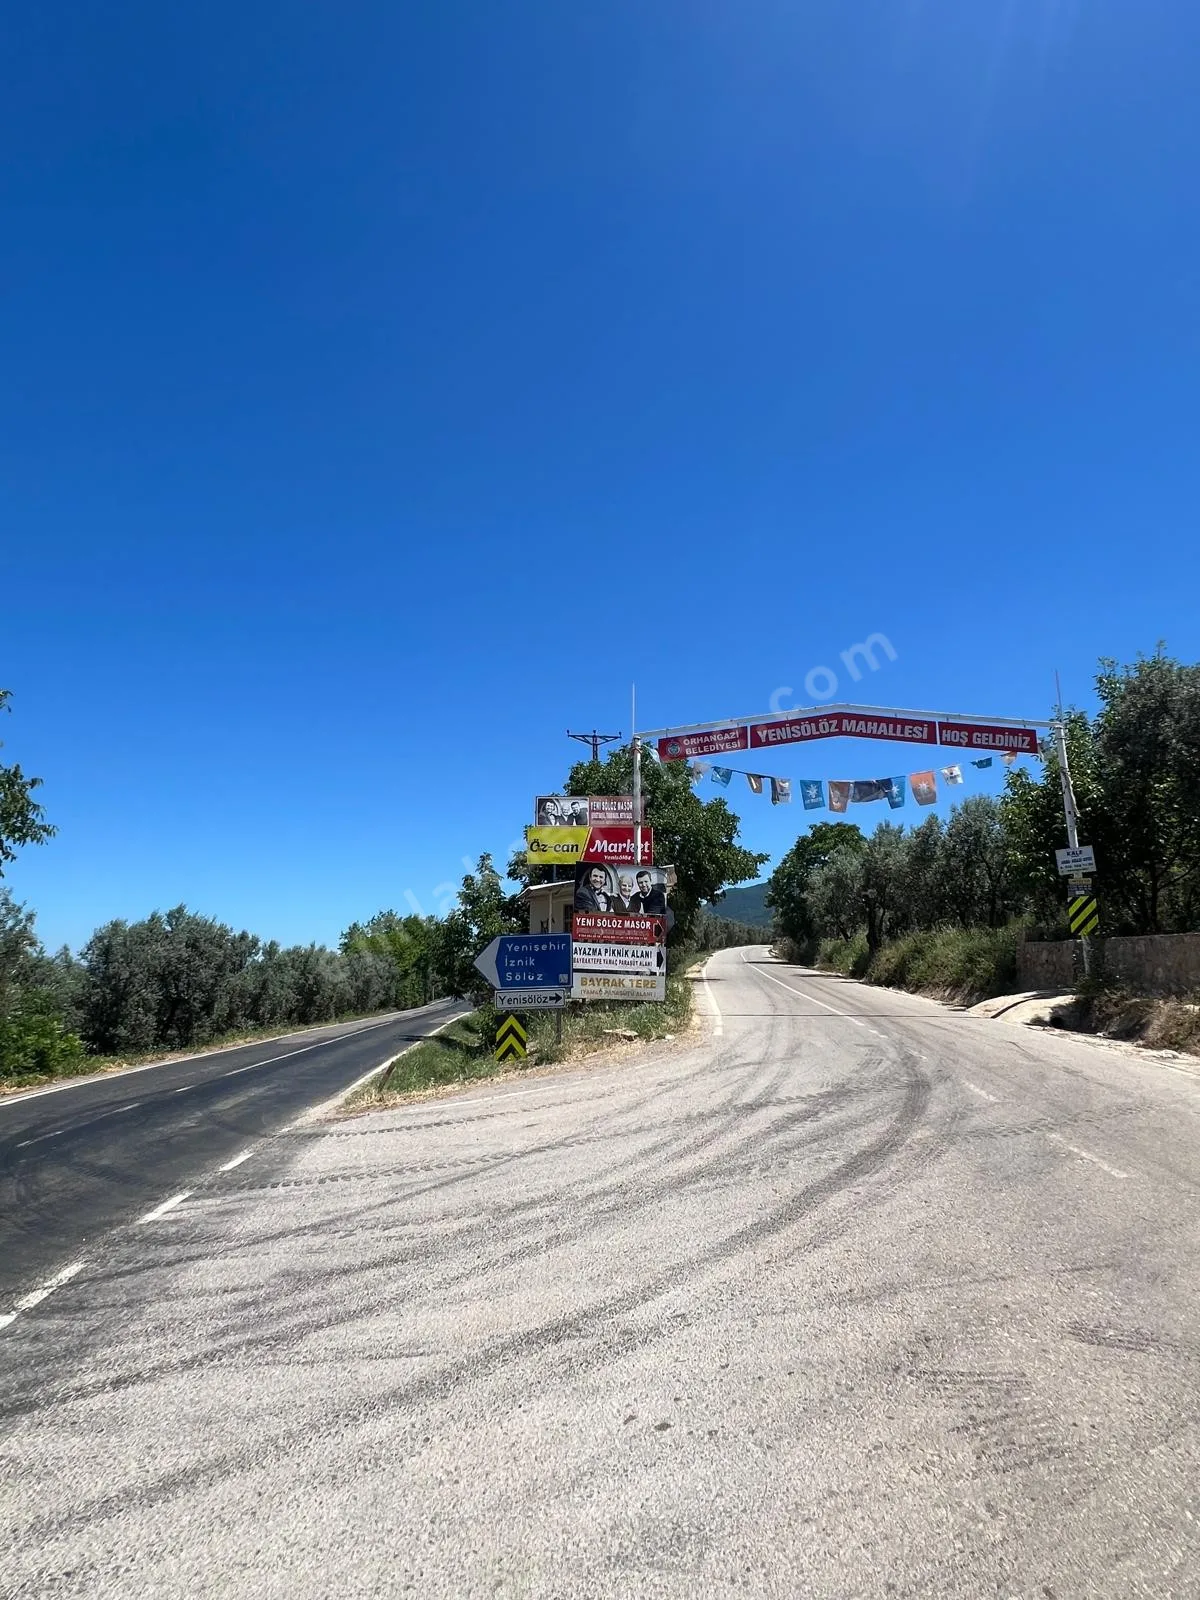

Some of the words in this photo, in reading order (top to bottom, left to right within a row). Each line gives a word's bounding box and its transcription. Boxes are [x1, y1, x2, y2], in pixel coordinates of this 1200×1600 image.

[757, 719, 839, 743] YENİSÖLÖZ
[842, 719, 928, 740] MAHALLESİ
[683, 731, 740, 746] ORHANGAZİ
[942, 729, 968, 745] HOŞ
[972, 731, 1031, 749] GELDİNİZ
[685, 741, 741, 755] BELEDİYESİ
[530, 838, 579, 853] Öz-can
[576, 917, 594, 926] YENİ
[506, 941, 566, 952] Yenişehir
[573, 947, 602, 956] AYAZMA
[604, 947, 629, 957] PİKNİK
[631, 949, 652, 959] ALANI
[505, 955, 535, 967] İznik
[580, 977, 625, 988] BAYRAK
[498, 994, 549, 1005] Yenisölöz
